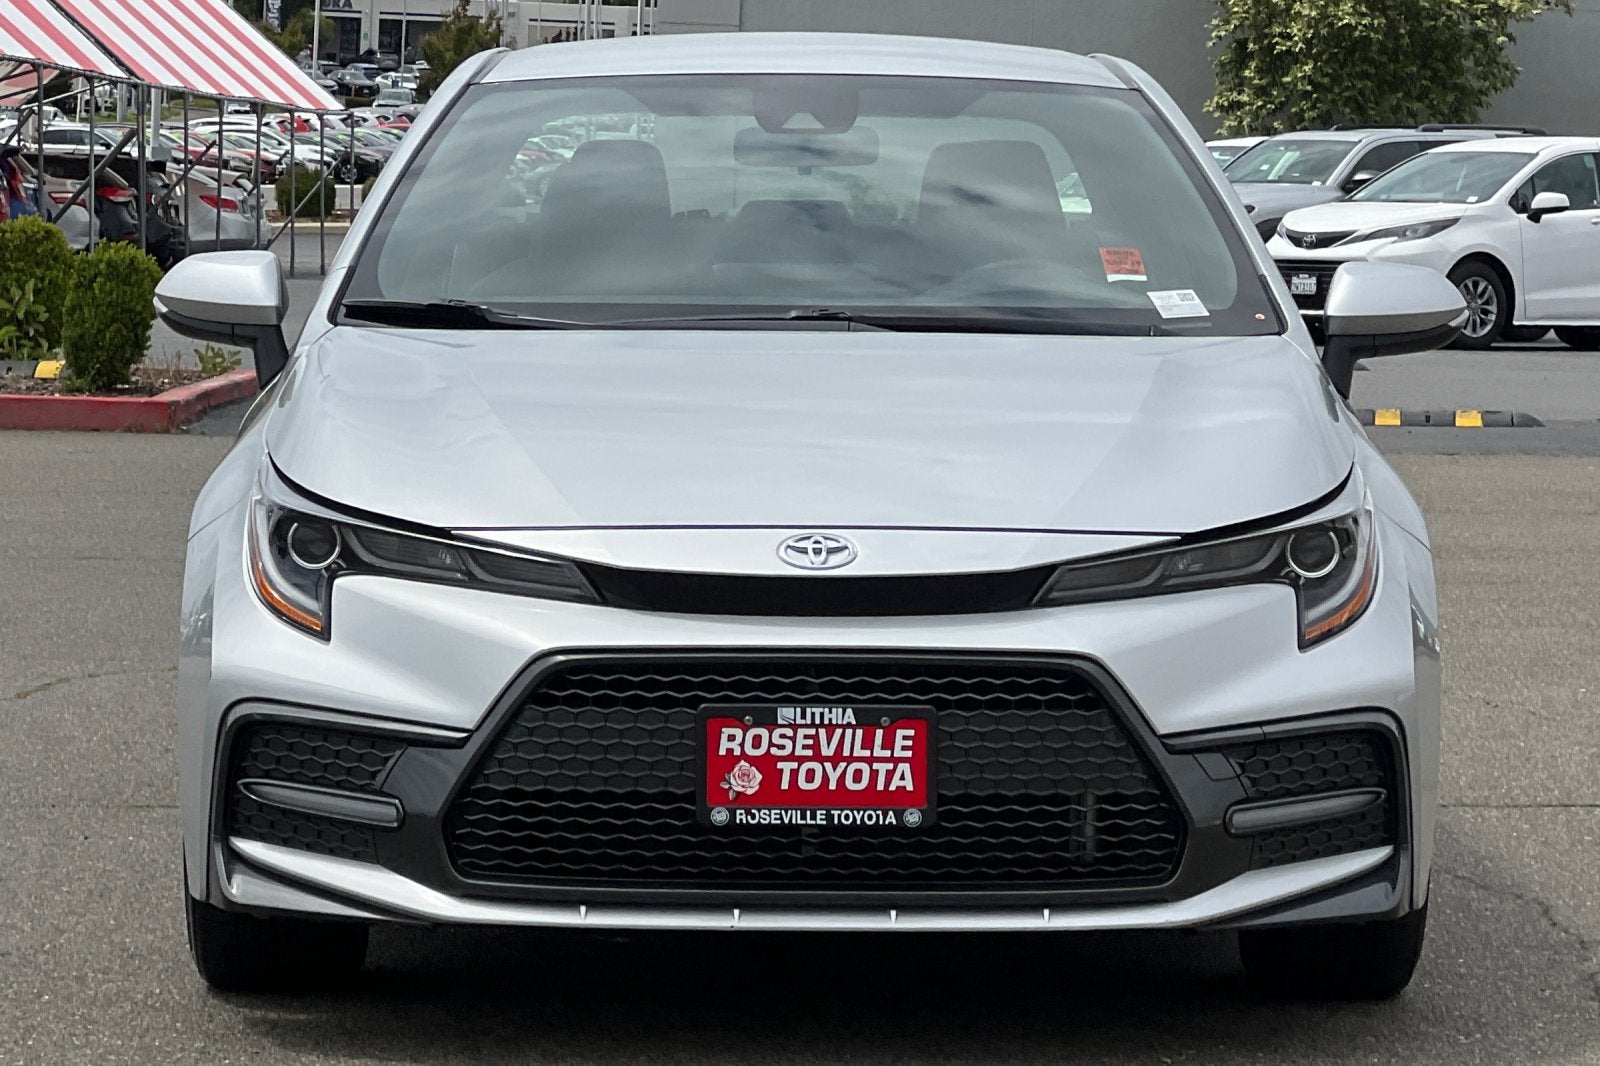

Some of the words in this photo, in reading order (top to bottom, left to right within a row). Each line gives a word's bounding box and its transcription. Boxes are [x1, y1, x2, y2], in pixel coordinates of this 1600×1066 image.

[795, 707, 856, 725] LITHIA
[718, 727, 915, 758] ROSEVILLE
[777, 761, 914, 791] TOYOTA
[735, 809, 826, 825] ROSEVILLE
[831, 810, 897, 825] TOYOTA
